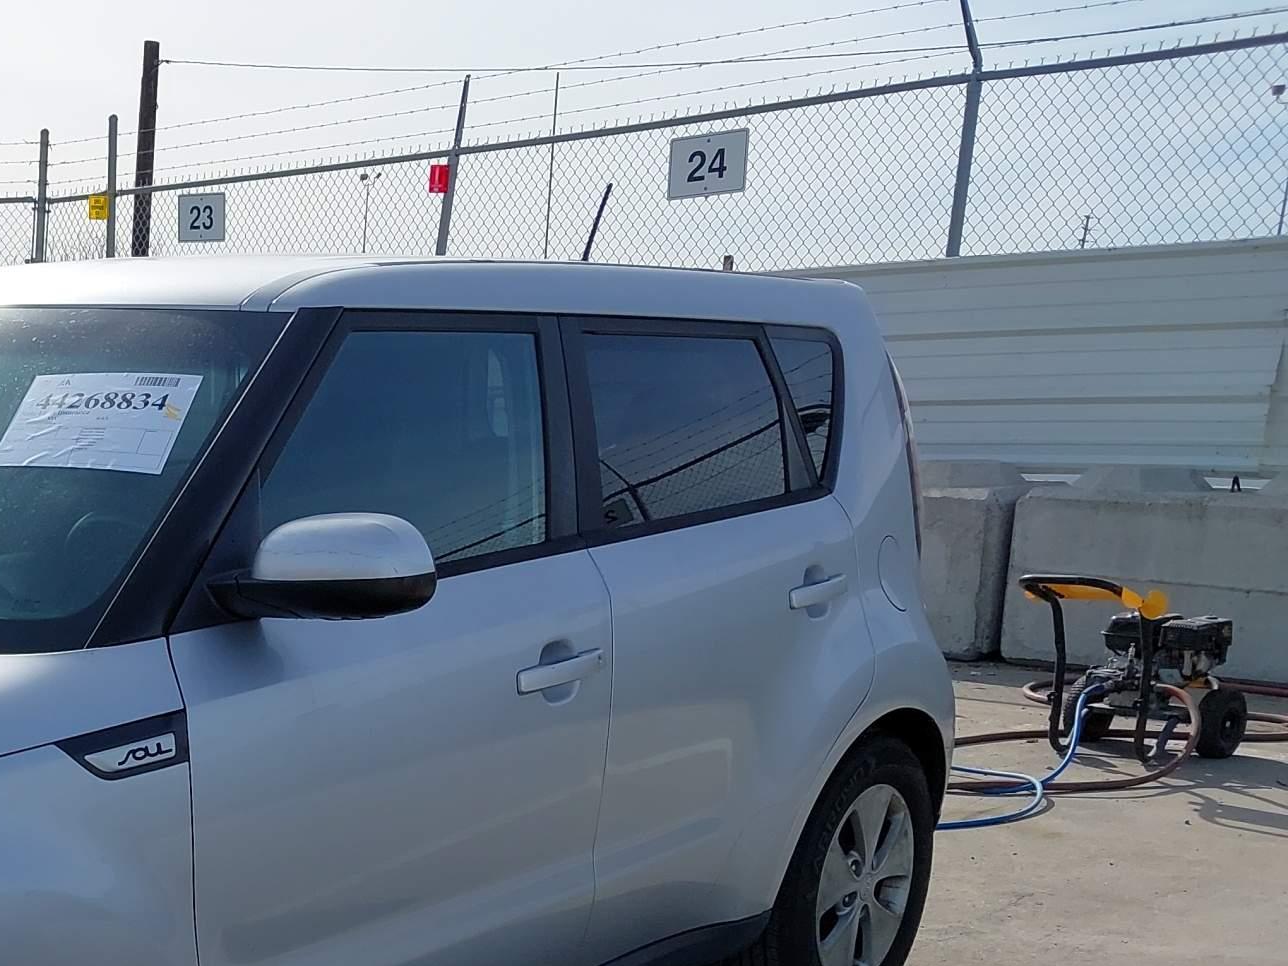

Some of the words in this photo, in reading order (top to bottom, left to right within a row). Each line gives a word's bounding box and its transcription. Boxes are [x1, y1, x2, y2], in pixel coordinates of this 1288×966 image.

[687, 148, 727, 183] 24
[189, 205, 213, 230] 23
[35, 391, 170, 411] 44268834
